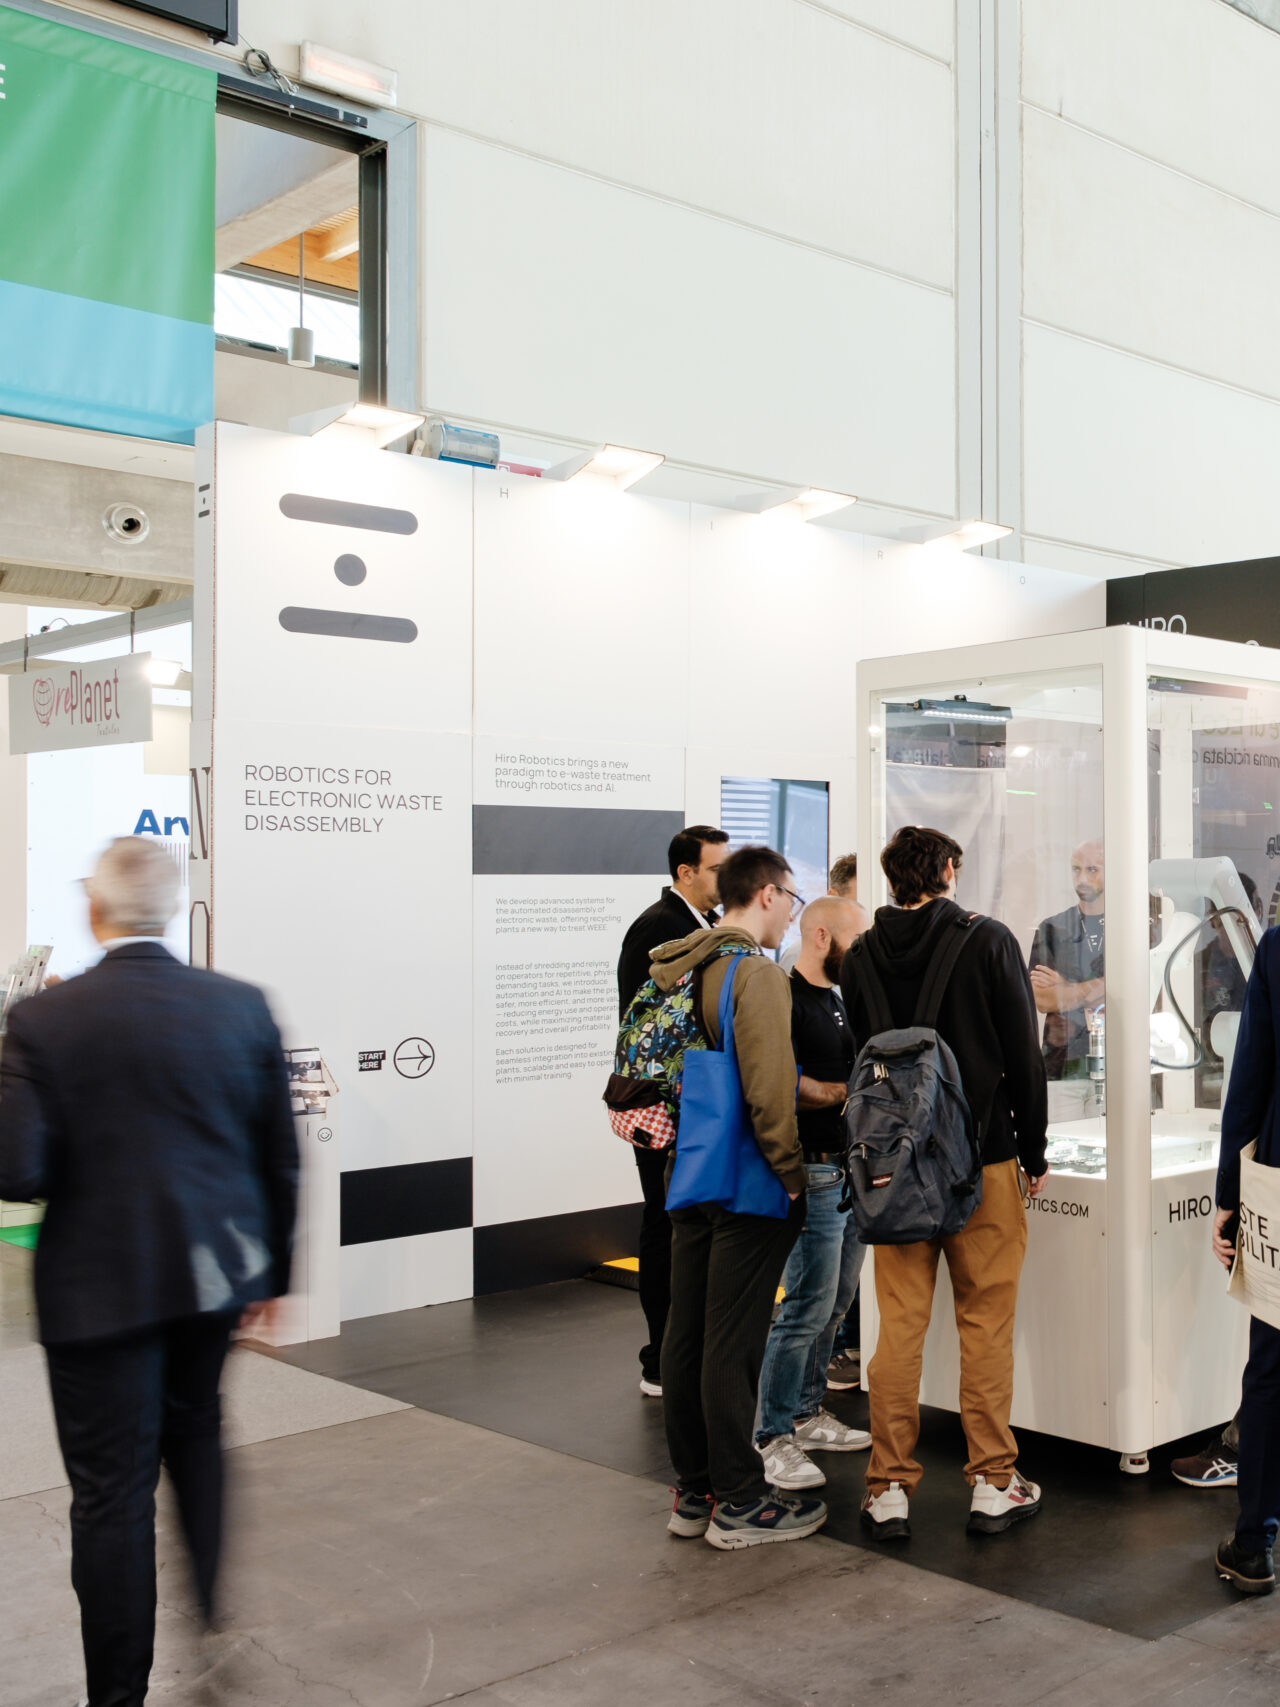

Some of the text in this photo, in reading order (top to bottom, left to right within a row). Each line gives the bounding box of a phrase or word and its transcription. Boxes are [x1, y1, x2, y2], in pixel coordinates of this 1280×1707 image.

[495, 753, 629, 770] Hiro Robotics brings a new
[244, 764, 392, 786] ROBOTICS FOR
[495, 766, 652, 783] paradigm to e-waste treatment
[495, 778, 538, 791] through
[540, 780, 583, 792] robotics
[584, 783, 603, 792] and
[244, 789, 443, 811] ELECTRONIC WASTE
[244, 814, 384, 833] DISASSEMBLY
[509, 897, 538, 906] develop
[539, 897, 574, 905] advanced
[575, 898, 605, 907] systems
[552, 906, 597, 915] disassembly
[496, 916, 534, 924] electronic
[560, 915, 589, 924] offering
[590, 914, 622, 924] recycling
[496, 925, 520, 934] plants
[543, 926, 558, 934] way
[568, 924, 586, 932] treat
[496, 963, 523, 971] Instead
[525, 962, 533, 970] of
[534, 962, 570, 971] shredding
[586, 960, 609, 970] relying
[507, 971, 543, 981] operators
[544, 970, 555, 978] for
[593, 969, 617, 977] physic
[496, 982, 537, 990] demanding
[574, 978, 608, 986] introduce
[496, 991, 539, 999] automation
[540, 989, 554, 997] and
[572, 987, 591, 995] make
[606, 987, 619, 995] pro
[503, 1009, 537, 1018] reducing
[538, 1008, 563, 1017] energy
[593, 1005, 617, 1014] operat
[520, 1018, 540, 1026] while
[541, 1017, 582, 1025] maximizing
[583, 1014, 612, 1022] material
[496, 1029, 528, 1037] recovery
[545, 1025, 568, 1033] overall
[496, 1048, 514, 1056] Each
[515, 1046, 546, 1054] solution
[554, 1043, 587, 1052] designed
[360, 1052, 384, 1061] START
[496, 1057, 531, 1065] seamless
[532, 1053, 573, 1062] integration
[523, 1064, 553, 1072] scalable
[555, 1062, 568, 1070] and
[570, 1062, 586, 1070] easy
[596, 1059, 615, 1067] oper
[514, 1074, 543, 1082] minimal
[1024, 1194, 1211, 1223] OTICS.COM HIRO
[1240, 1201, 1269, 1240] STE
